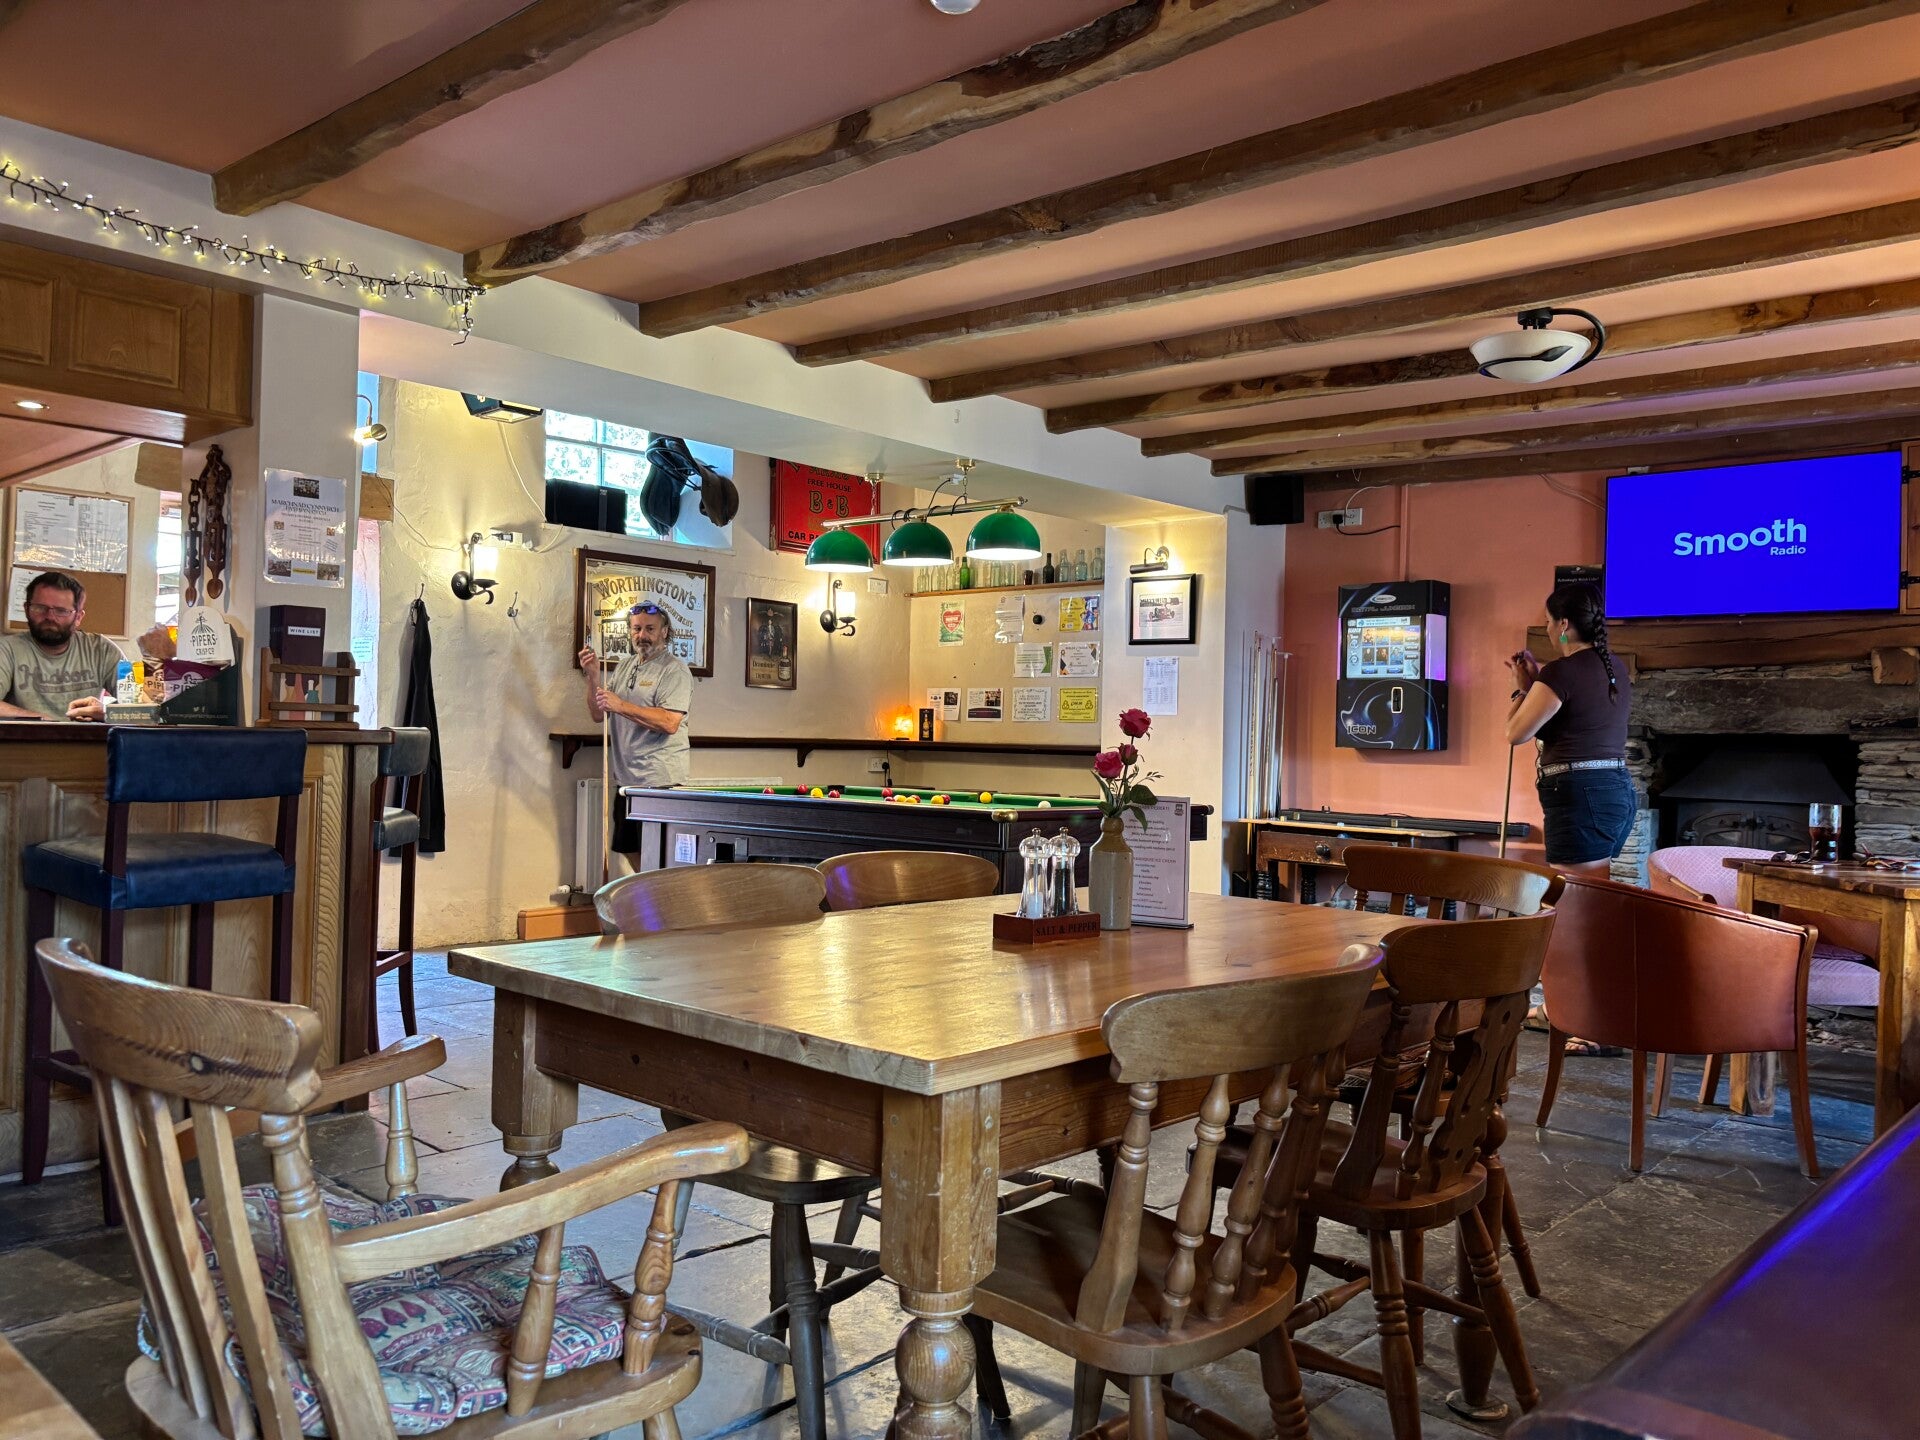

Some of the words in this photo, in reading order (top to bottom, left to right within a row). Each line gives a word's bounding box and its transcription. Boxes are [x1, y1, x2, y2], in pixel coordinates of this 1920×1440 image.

[807, 478, 824, 487] FREE
[826, 482, 852, 492] HOUSE
[809, 490, 824, 514] B
[826, 499, 833, 509] &
[835, 495, 849, 518] B
[788, 530, 806, 540] CAR
[1673, 518, 1807, 556] Smooth
[1770, 545, 1807, 556] Radio
[592, 576, 697, 611] WORTHINGTON'S
[657, 597, 694, 628] APPOINTMENT
[191, 633, 217, 647] PIPERS
[18, 663, 95, 691] Hudson
[1346, 725, 1377, 735] ICON
[1035, 926, 1057, 937] SALT
[1058, 924, 1066, 935] &
[1068, 922, 1097, 933] PEPPER
